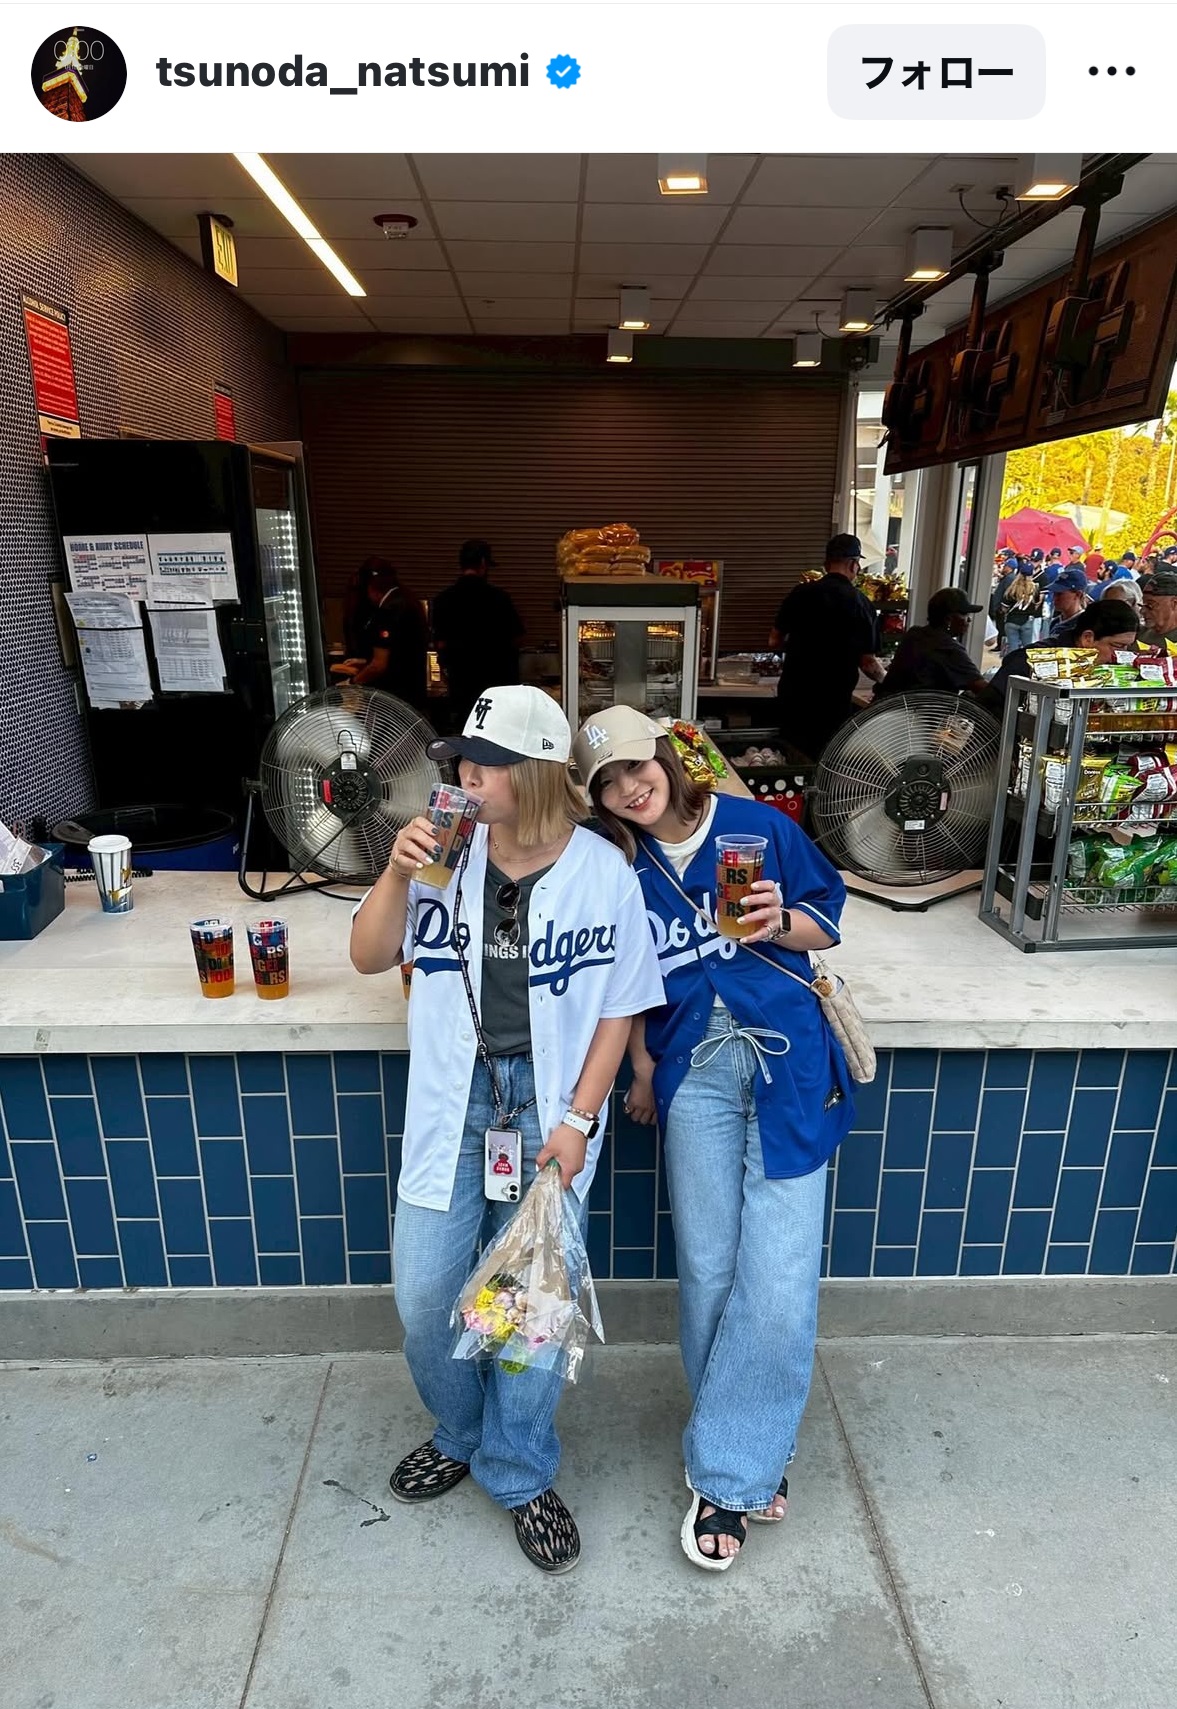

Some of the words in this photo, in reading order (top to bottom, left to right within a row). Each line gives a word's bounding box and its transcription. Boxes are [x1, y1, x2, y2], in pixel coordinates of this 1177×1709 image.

[70, 543, 88, 552] HOME
[113, 541, 144, 550] SCHEDULE
[584, 724, 610, 750] LA
